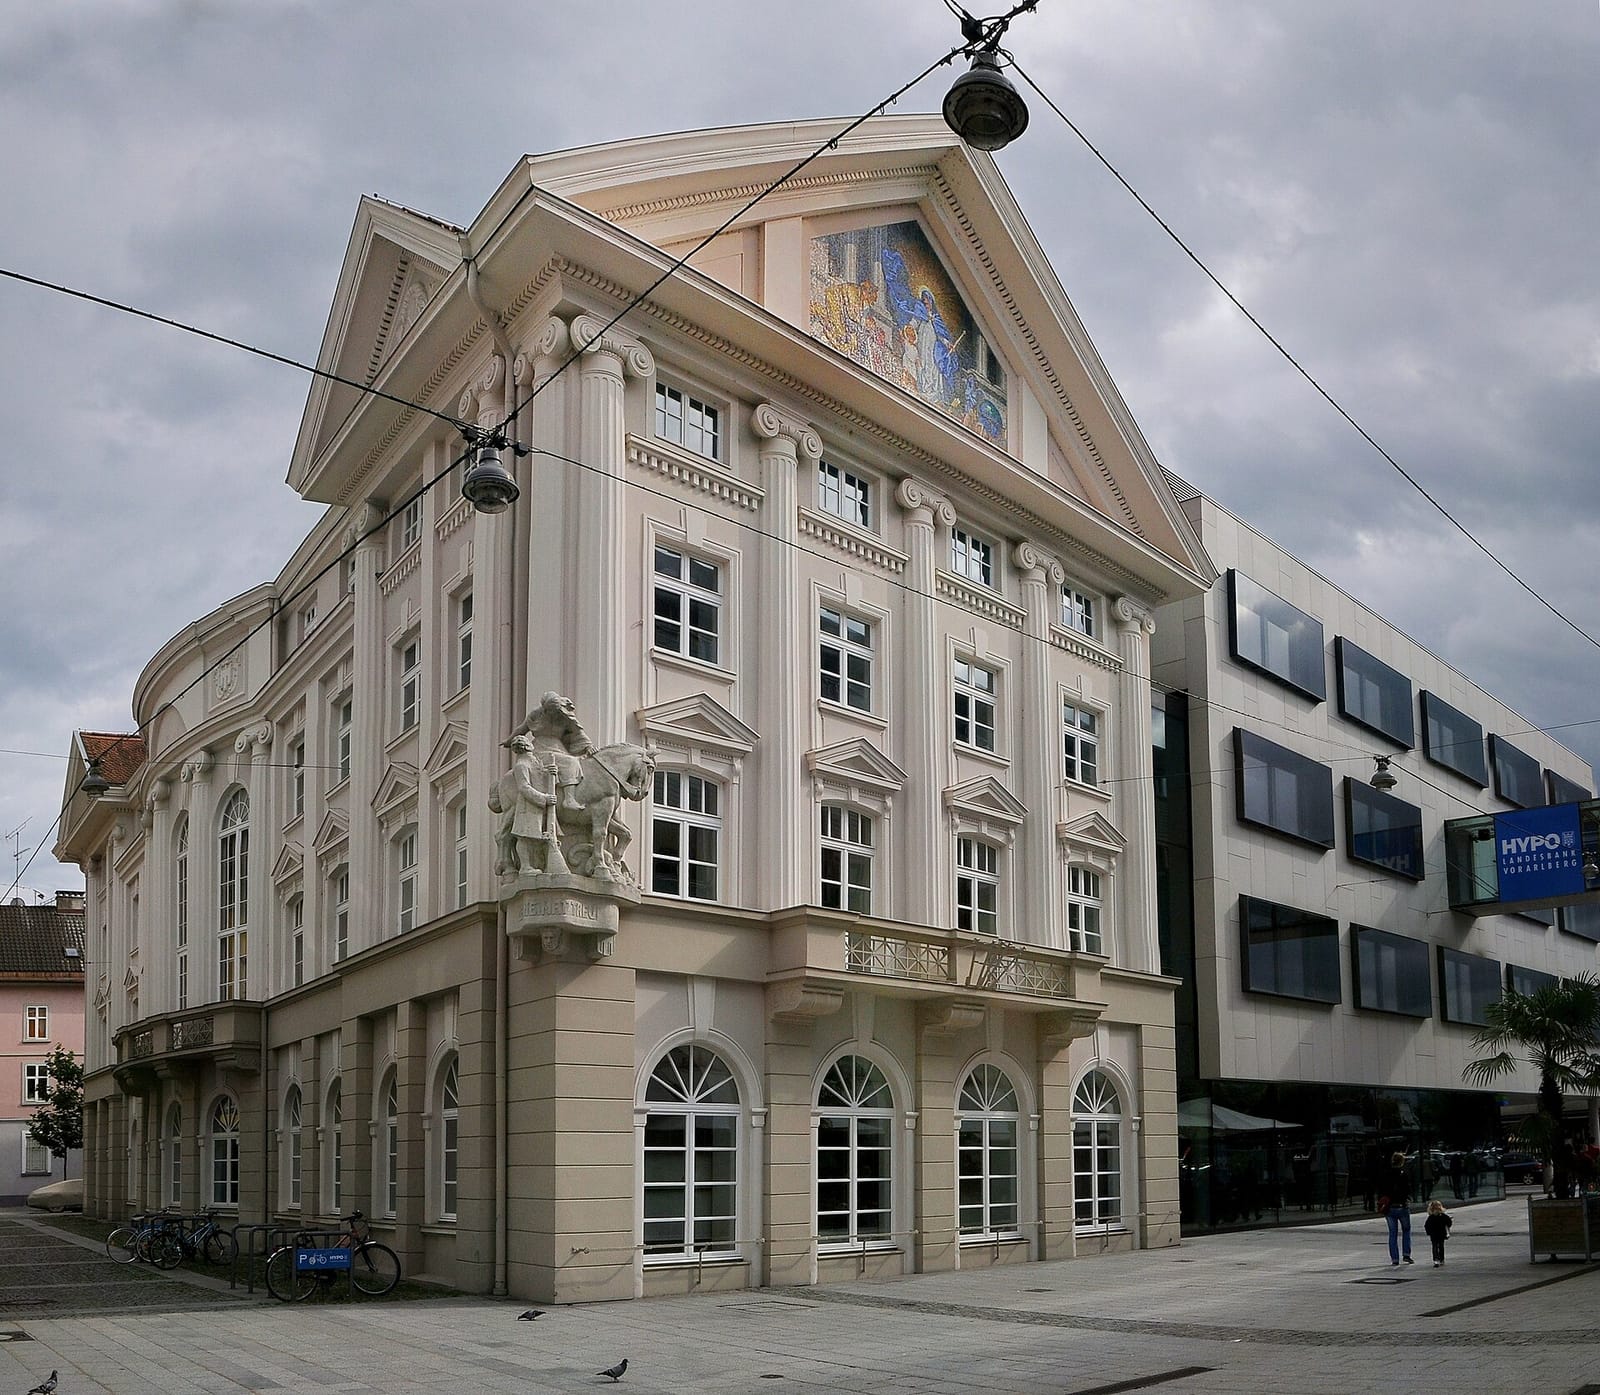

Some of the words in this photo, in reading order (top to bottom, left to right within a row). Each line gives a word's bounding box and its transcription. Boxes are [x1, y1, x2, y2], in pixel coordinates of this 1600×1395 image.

[1502, 833, 1560, 855] HYPO
[1502, 850, 1576, 865] LANDESBANK
[1503, 860, 1577, 875] VORARLBERG
[300, 1254, 307, 1264] P
